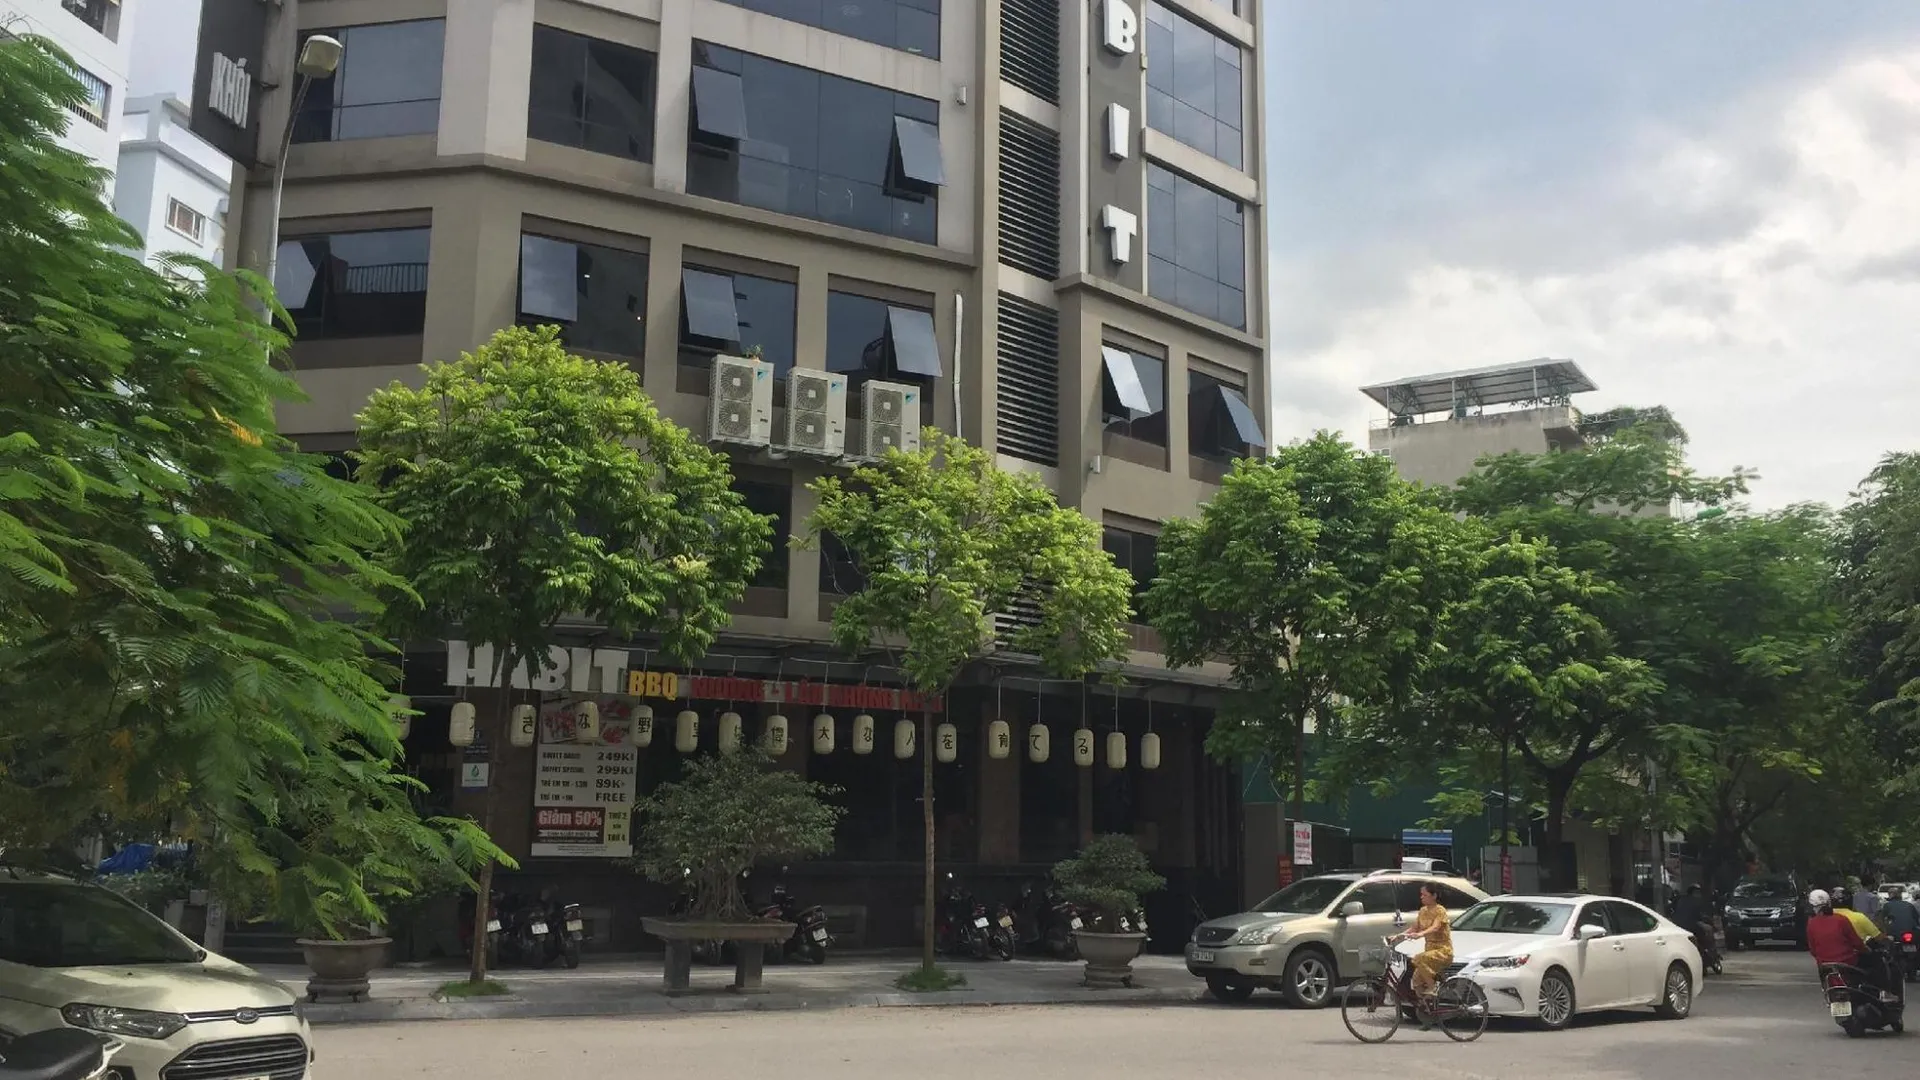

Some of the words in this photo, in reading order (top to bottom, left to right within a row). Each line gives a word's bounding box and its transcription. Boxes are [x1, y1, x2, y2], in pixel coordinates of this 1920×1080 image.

[628, 671, 679, 701] BBQ
[577, 713, 591, 732] な
[818, 725, 831, 741] 大
[942, 733, 954, 750] を
[1029, 733, 1042, 751] て
[1077, 736, 1089, 755] る
[595, 792, 628, 802] FREE
[575, 810, 603, 827] 50%
